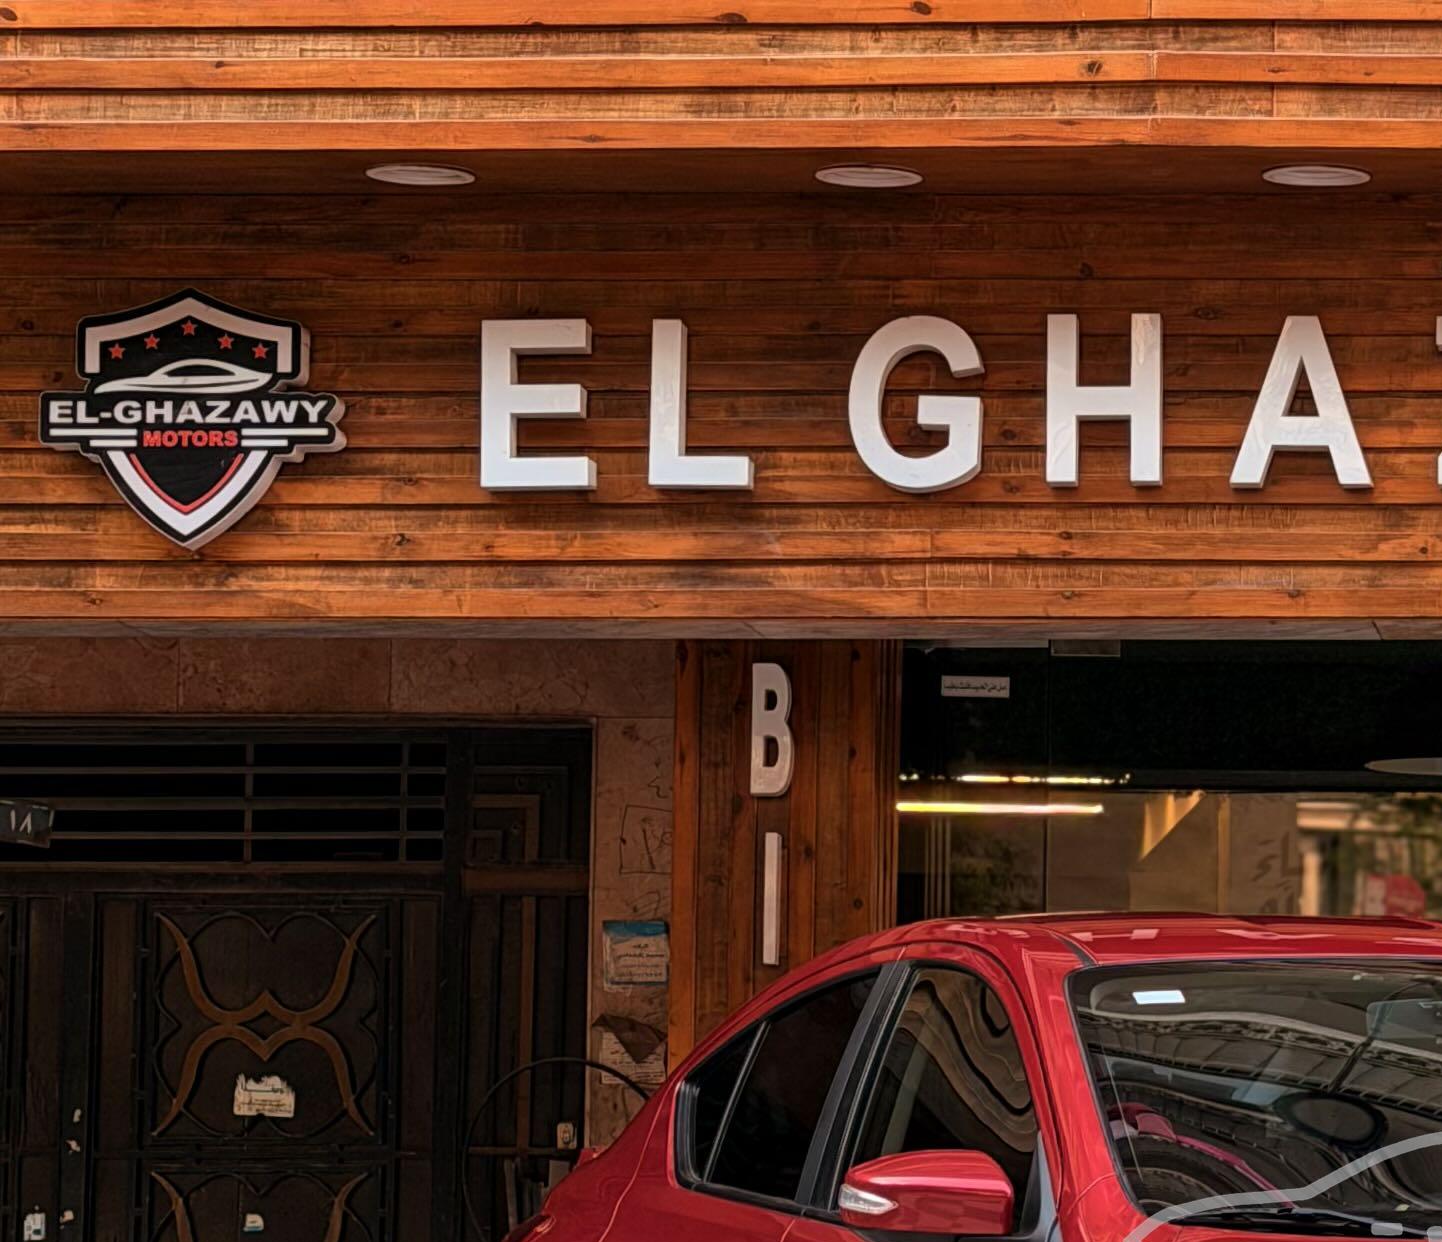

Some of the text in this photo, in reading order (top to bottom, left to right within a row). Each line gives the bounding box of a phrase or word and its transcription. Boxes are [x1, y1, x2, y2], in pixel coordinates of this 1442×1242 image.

[48, 400, 330, 424] EL-GHAZAWY
[480, 317, 755, 491] EL
[142, 430, 240, 449] MOTORS
